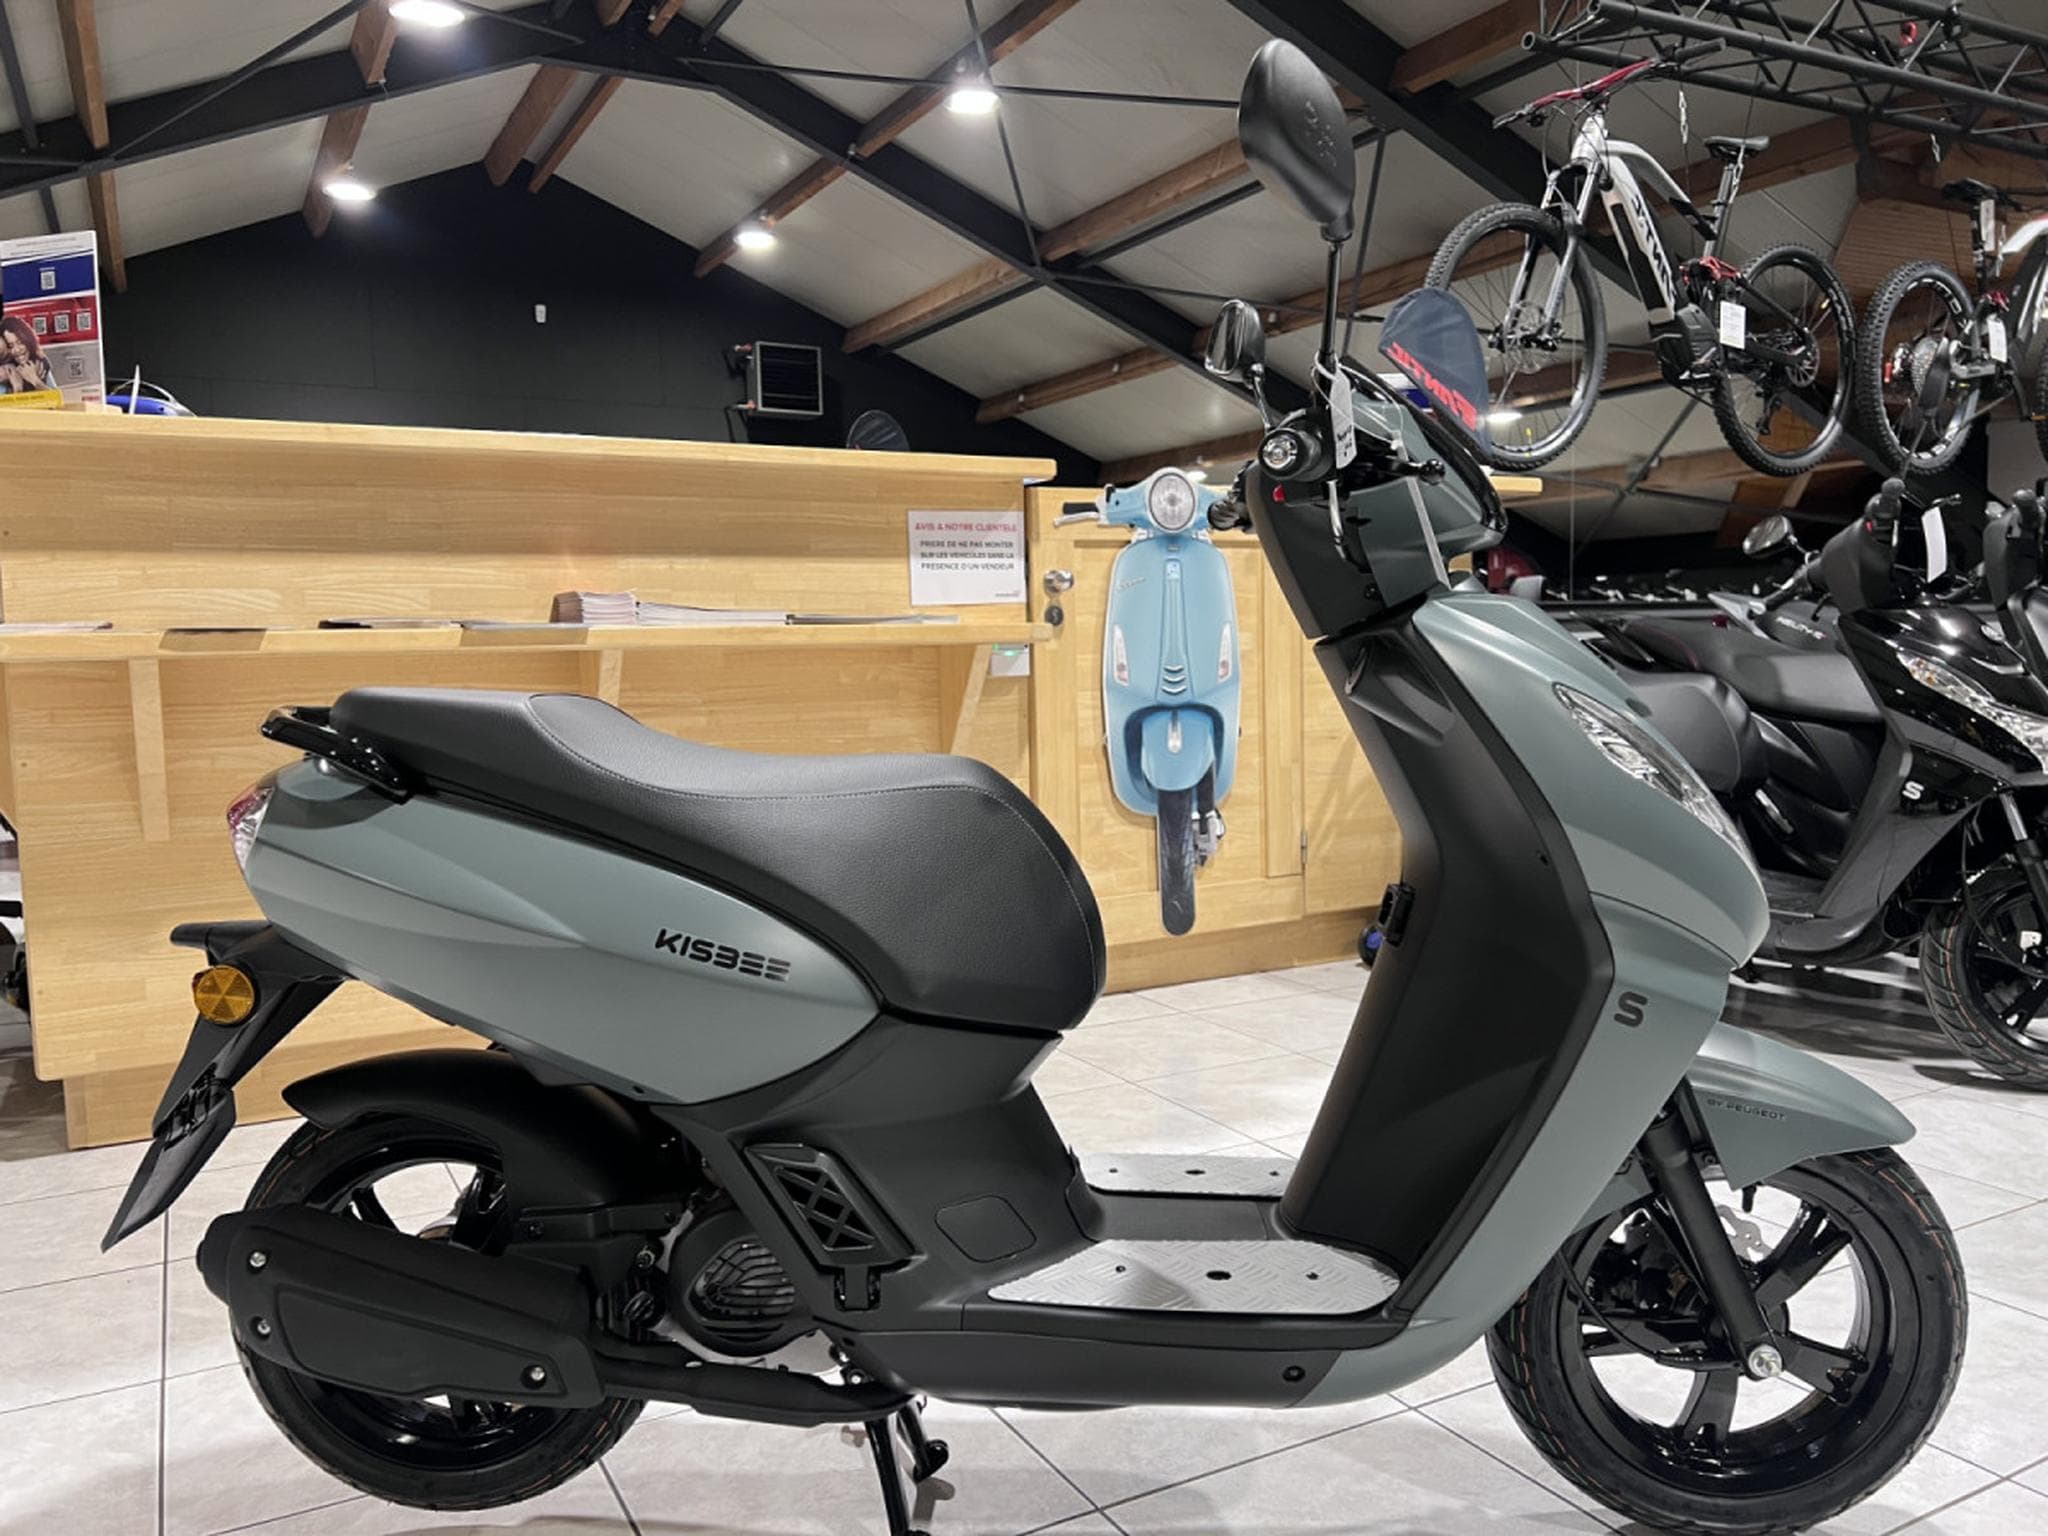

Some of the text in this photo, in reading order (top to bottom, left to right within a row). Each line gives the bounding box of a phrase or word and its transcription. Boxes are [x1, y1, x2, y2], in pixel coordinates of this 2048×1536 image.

[915, 522, 935, 531] AVIS
[945, 523, 973, 531] NOTRE
[946, 540, 956, 548] DE
[958, 540, 968, 548] NE
[970, 540, 983, 548] PAS
[921, 562, 959, 570] PRESENCE
[1901, 781, 1925, 800] S
[655, 928, 791, 982] KISBEE
[1613, 991, 1648, 1028] S
[1707, 1098, 1786, 1120] BY PEUGEOT
